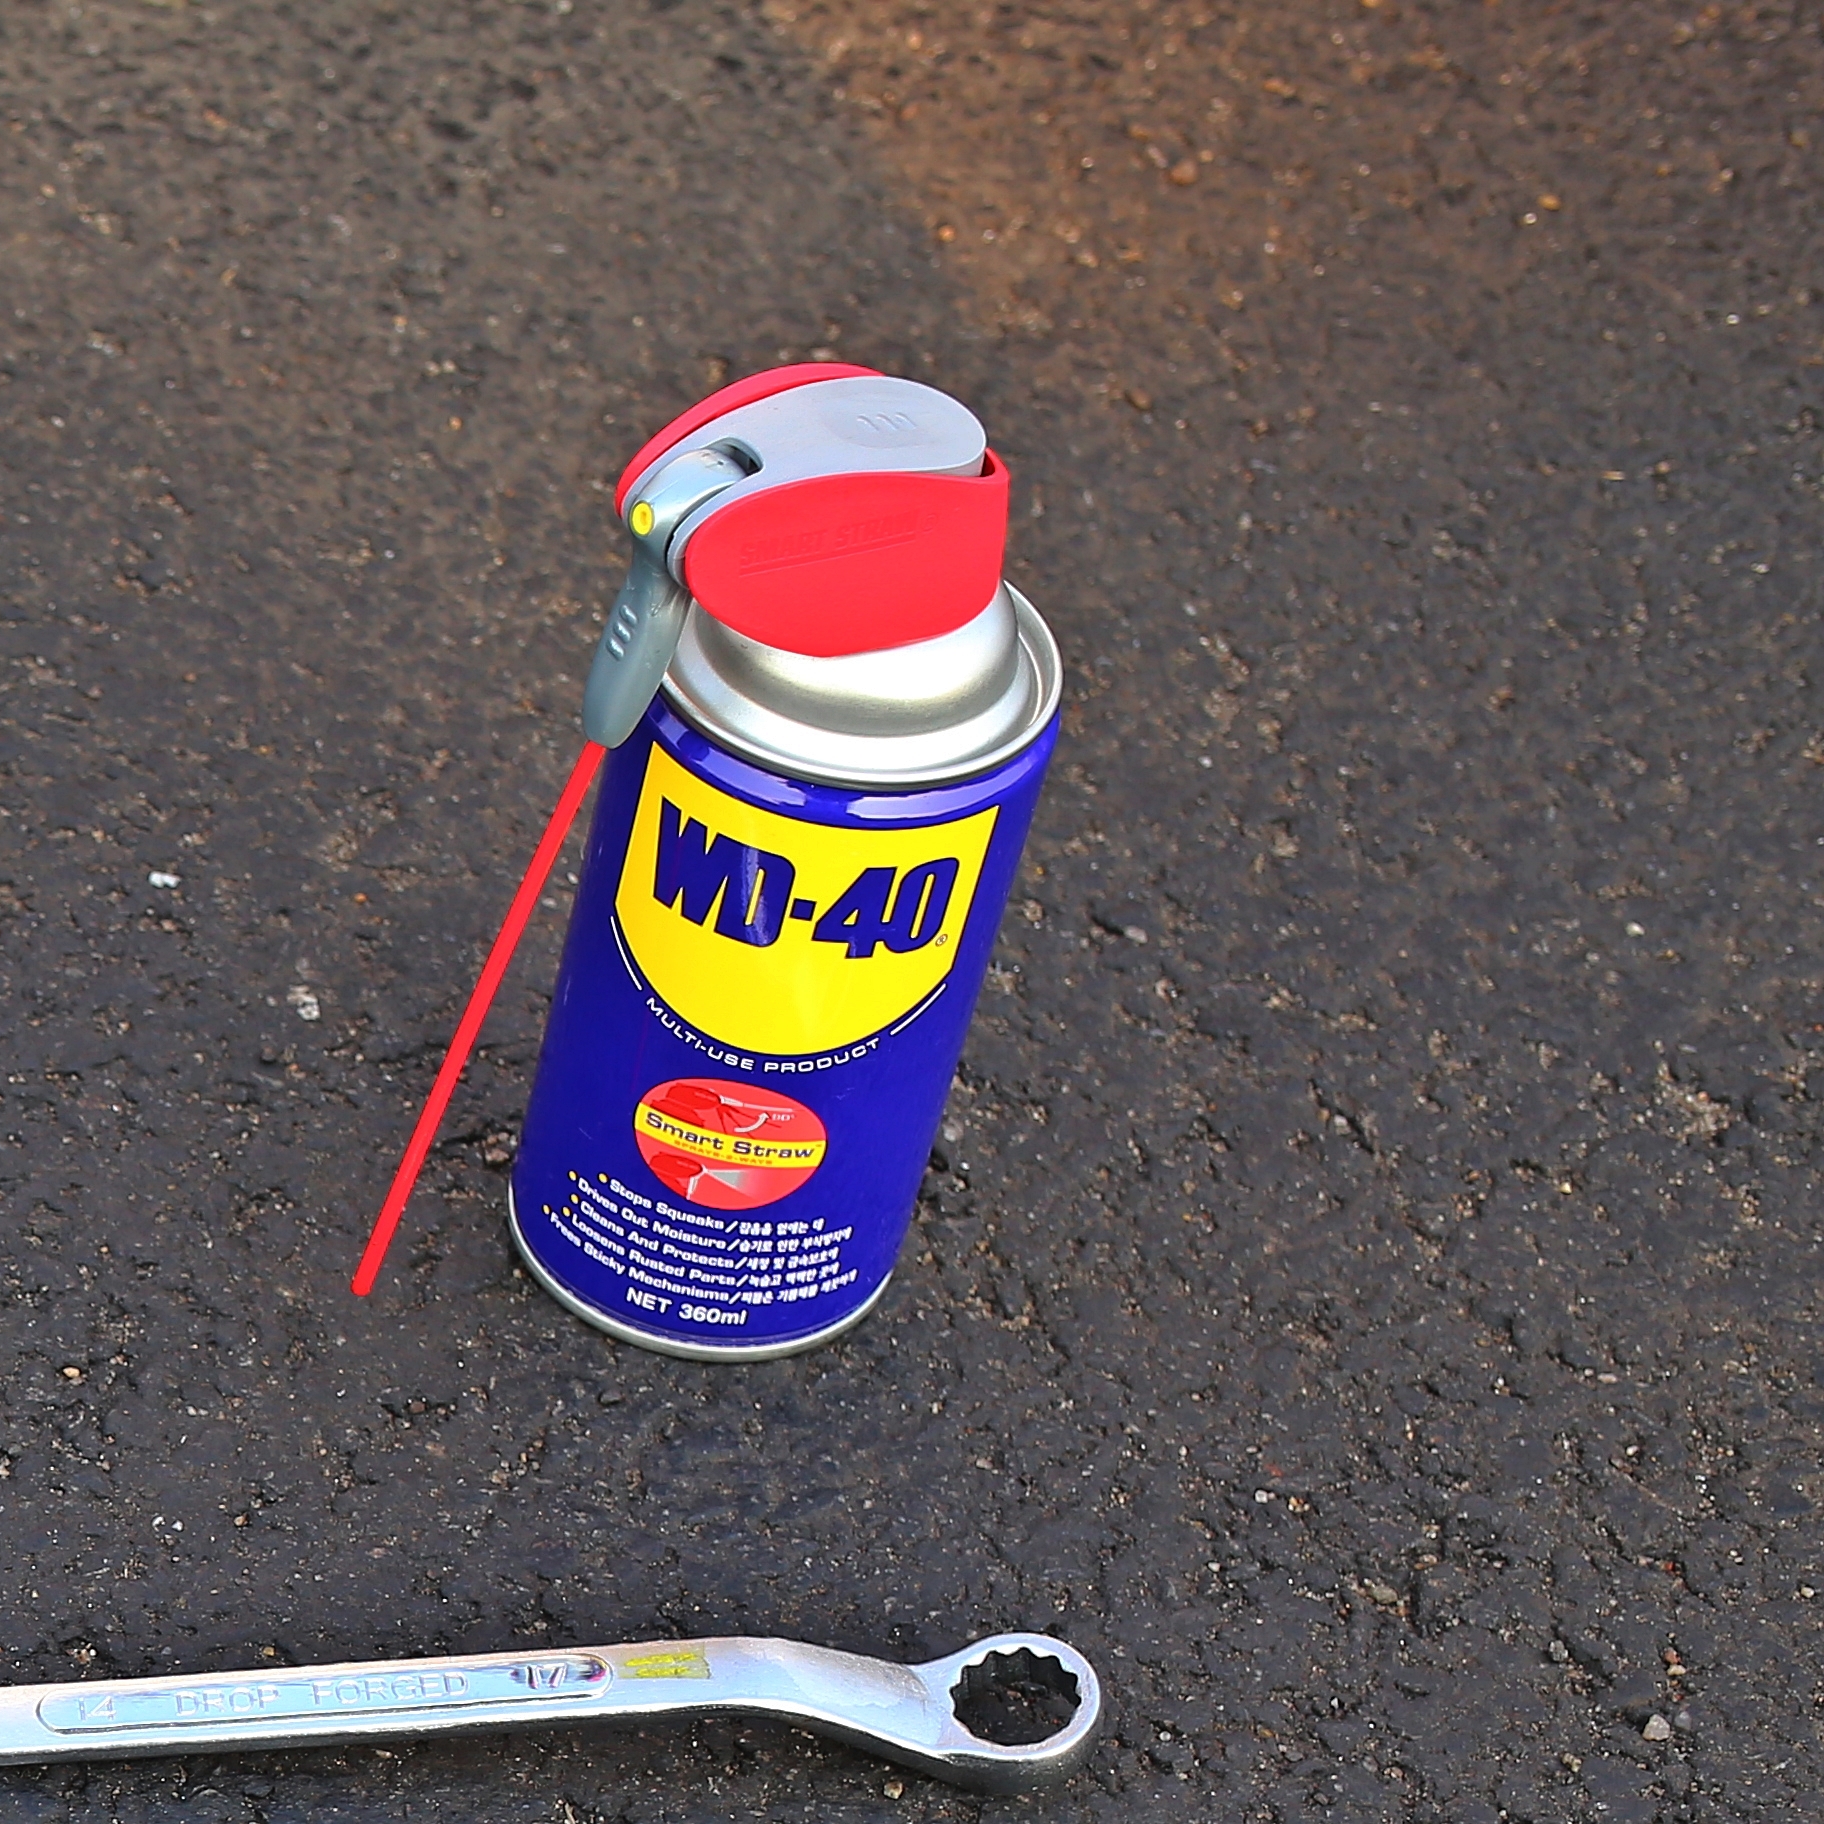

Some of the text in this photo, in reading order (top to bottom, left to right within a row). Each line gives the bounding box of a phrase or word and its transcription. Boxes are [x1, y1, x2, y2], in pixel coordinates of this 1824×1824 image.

[646, 997, 880, 1073] MULTI-USE PRODUCT
[645, 1111, 815, 1159] Smart Straw
[578, 1177, 618, 1213] Drives
[621, 1207, 649, 1229] Out
[609, 1178, 652, 1210] Stops
[550, 1213, 581, 1247] Frees
[584, 1240, 625, 1275] Sticky
[572, 1213, 625, 1259] Loosens
[629, 1247, 684, 1278] Rusted
[580, 1200, 624, 1241] Cleans
[627, 1229, 658, 1251] And
[626, 1287, 747, 1326] NET 360ml
[175, 1686, 282, 1718] DROP
[313, 1671, 471, 1707] FORGED
[526, 1663, 568, 1690] 17
